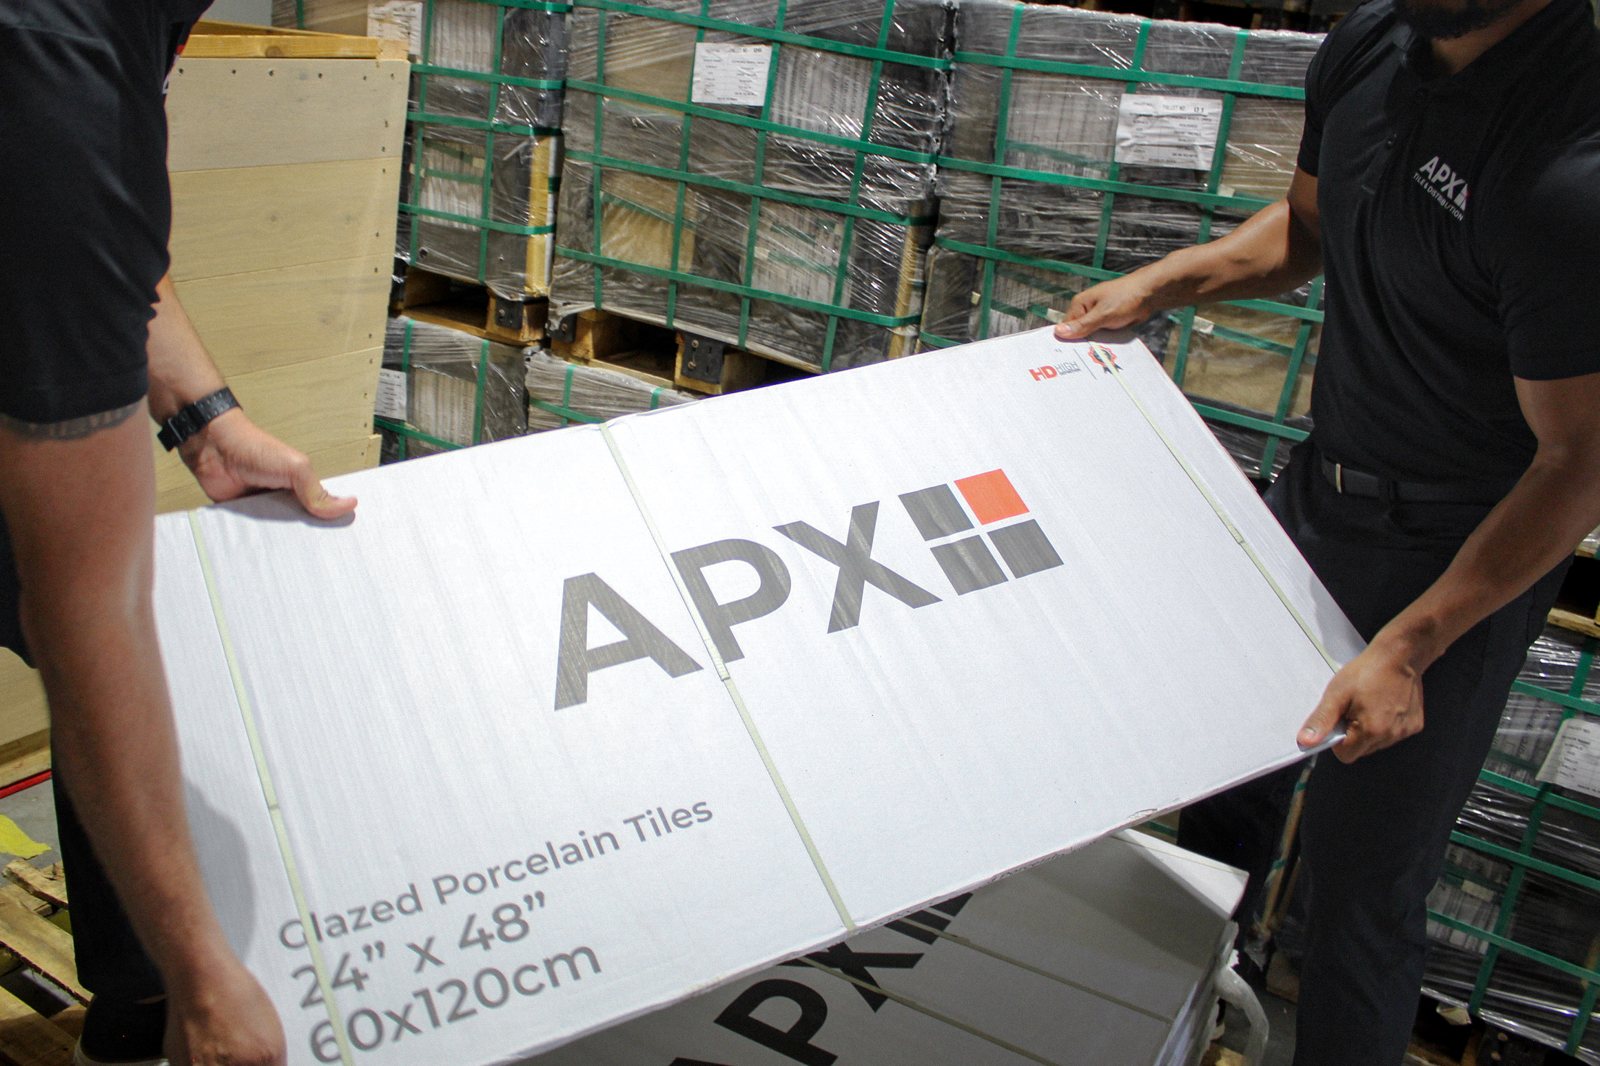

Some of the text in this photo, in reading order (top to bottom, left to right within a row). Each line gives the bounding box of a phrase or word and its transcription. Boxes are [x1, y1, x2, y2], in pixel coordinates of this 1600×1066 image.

[1413, 172, 1426, 187] TILE
[1427, 186, 1464, 221] DISTRIBUTION
[1419, 156, 1466, 200] APX
[1028, 365, 1057, 381] HD
[553, 500, 943, 712] APX
[279, 800, 714, 951] Glazed Porcelain Tiles
[309, 944, 603, 1065] 60x120cm
[668, 940, 925, 1066] PX
